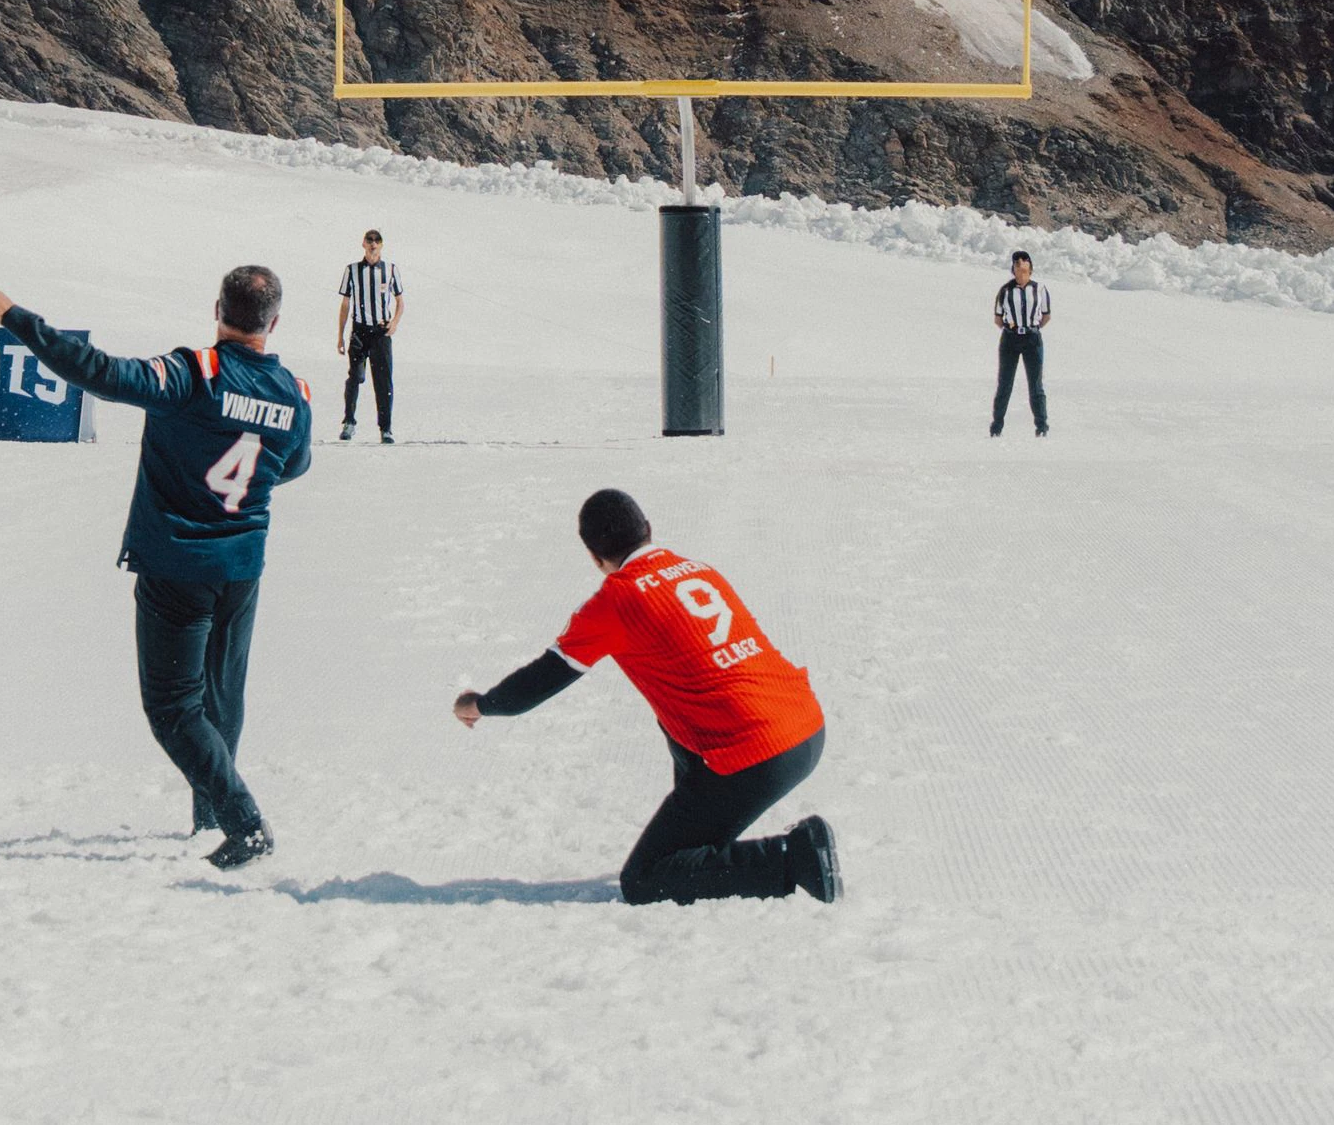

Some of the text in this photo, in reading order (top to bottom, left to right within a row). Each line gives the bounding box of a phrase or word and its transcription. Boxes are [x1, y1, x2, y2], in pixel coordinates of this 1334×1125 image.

[221, 390, 296, 432] VINATIERI
[206, 431, 263, 513] 4
[635, 573, 661, 593] FC
[675, 578, 733, 647] 9
[711, 637, 764, 670] ELBER
